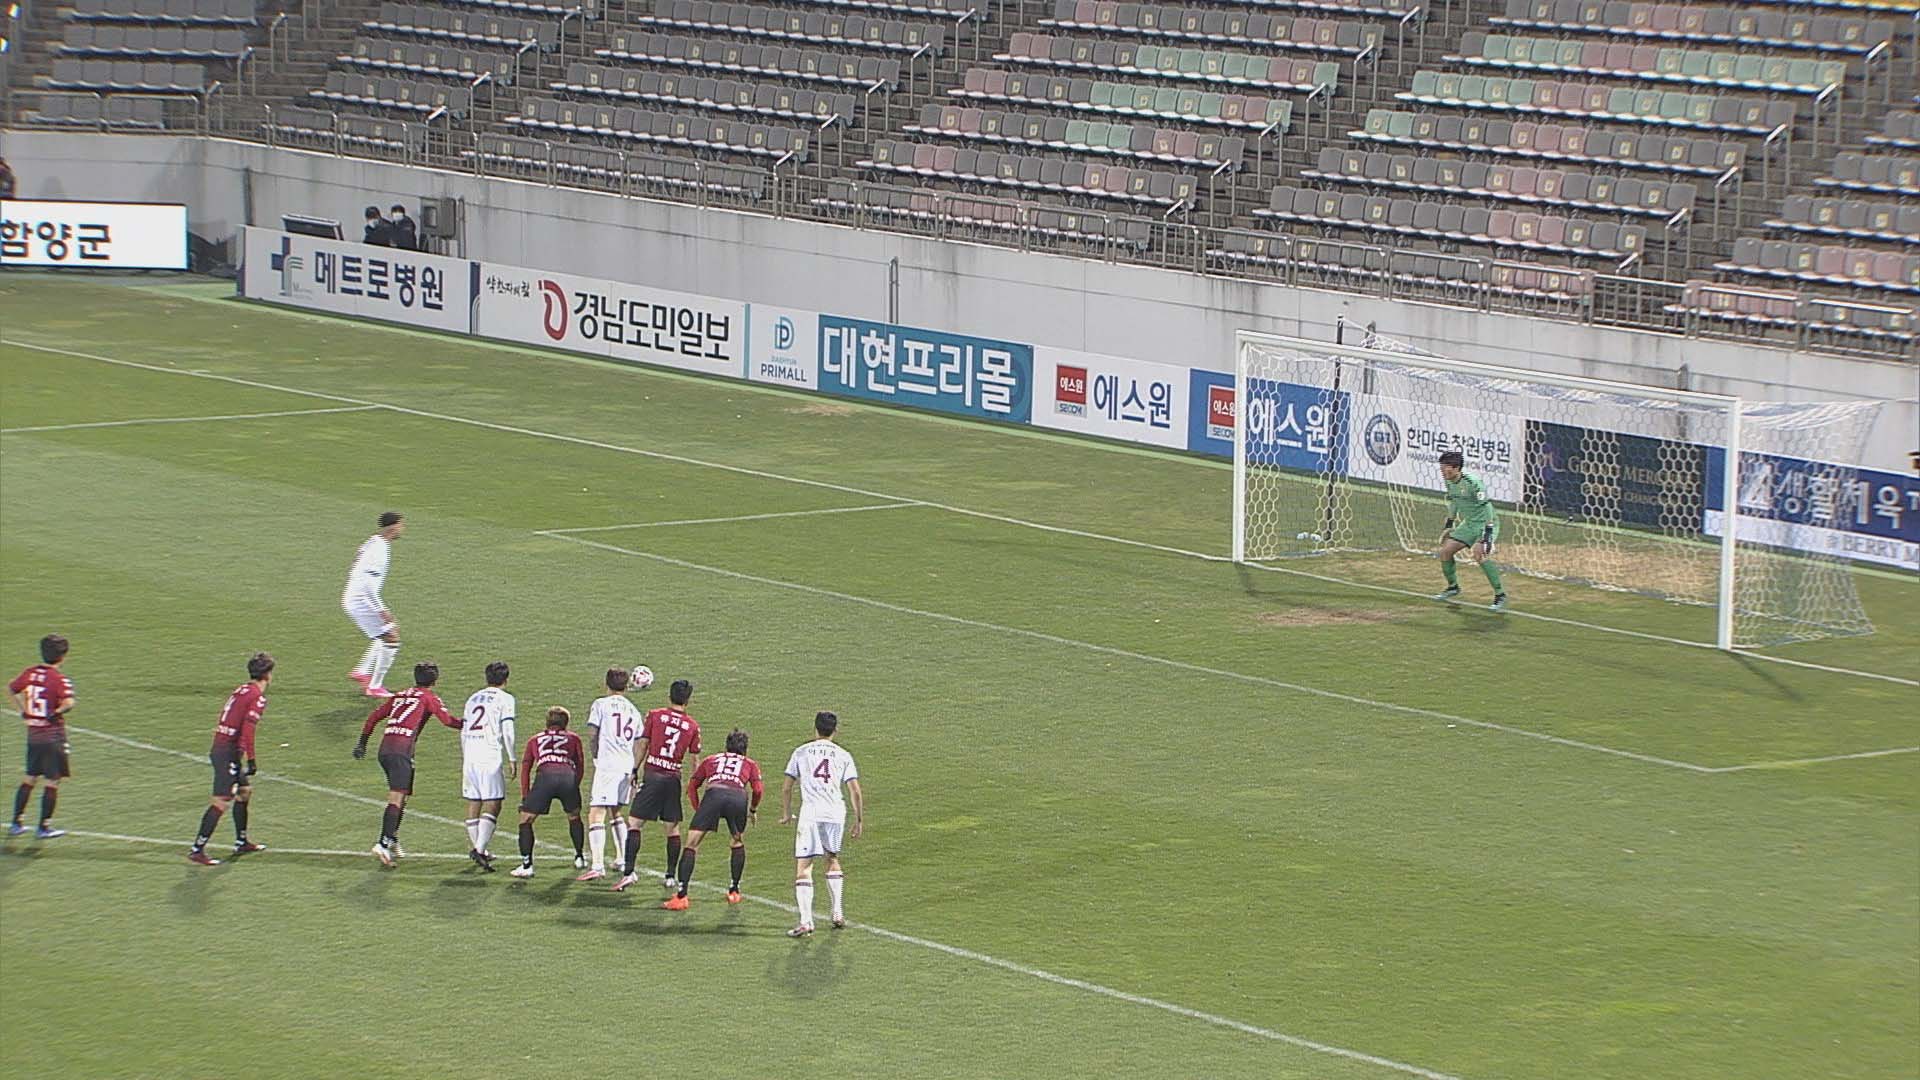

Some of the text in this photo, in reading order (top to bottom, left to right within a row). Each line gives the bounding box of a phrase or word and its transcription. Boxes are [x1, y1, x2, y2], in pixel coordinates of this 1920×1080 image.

[0, 220, 112, 261] 함양군
[314, 250, 444, 311] 메트로병원
[574, 290, 731, 362] 경남도민일보
[760, 363, 808, 382] PRIMALL
[822, 325, 1018, 414] 대현프리몰
[1060, 376, 1084, 394] 에스원
[1093, 374, 1172, 429] 에스원
[1248, 397, 1330, 455] 에스원
[1407, 427, 1511, 463] 한마음창원병원
[25, 684, 48, 717] 15
[469, 705, 486, 731] 2
[612, 713, 634, 741] 16
[536, 734, 570, 758] 22
[659, 726, 681, 759] 3
[715, 756, 744, 776] 19
[813, 758, 831, 784] 4
